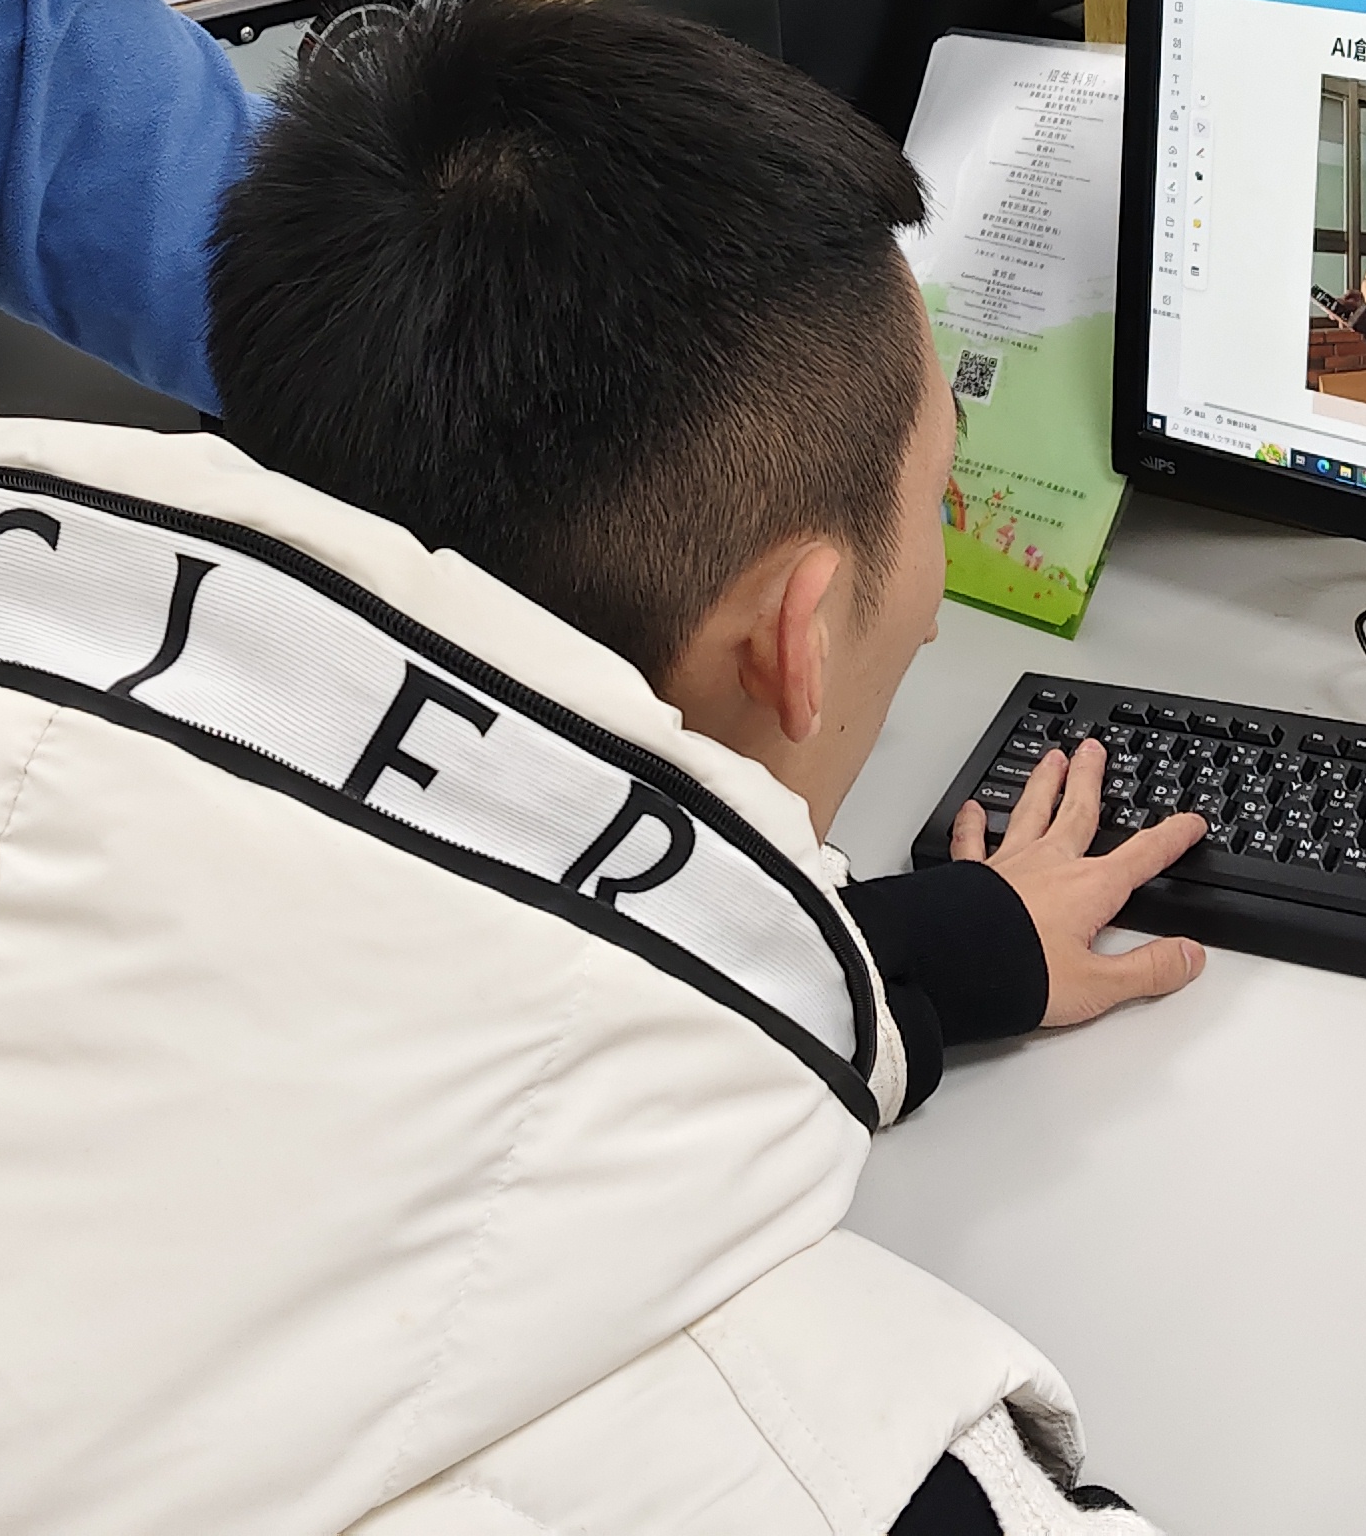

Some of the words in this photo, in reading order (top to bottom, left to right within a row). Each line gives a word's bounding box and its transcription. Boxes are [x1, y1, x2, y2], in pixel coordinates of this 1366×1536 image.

[1153, 455, 1176, 475] IPS
[1118, 753, 1132, 762] W
[1158, 759, 1170, 769] E
[1201, 767, 1213, 776] R
[1112, 779, 1124, 789] S
[1247, 774, 1257, 784] T
[1154, 786, 1167, 795] D
[1291, 781, 1302, 791] Y
[1199, 793, 1211, 803] F
[1335, 789, 1346, 799] U
[1244, 801, 1256, 811] G
[1121, 808, 1133, 818] X
[1288, 809, 1301, 819] H
[1333, 817, 1343, 827] J
[1210, 823, 1222, 833] V
[1254, 831, 1266, 841] B
[1299, 840, 1313, 850] N
[1346, 848, 1360, 858] M
